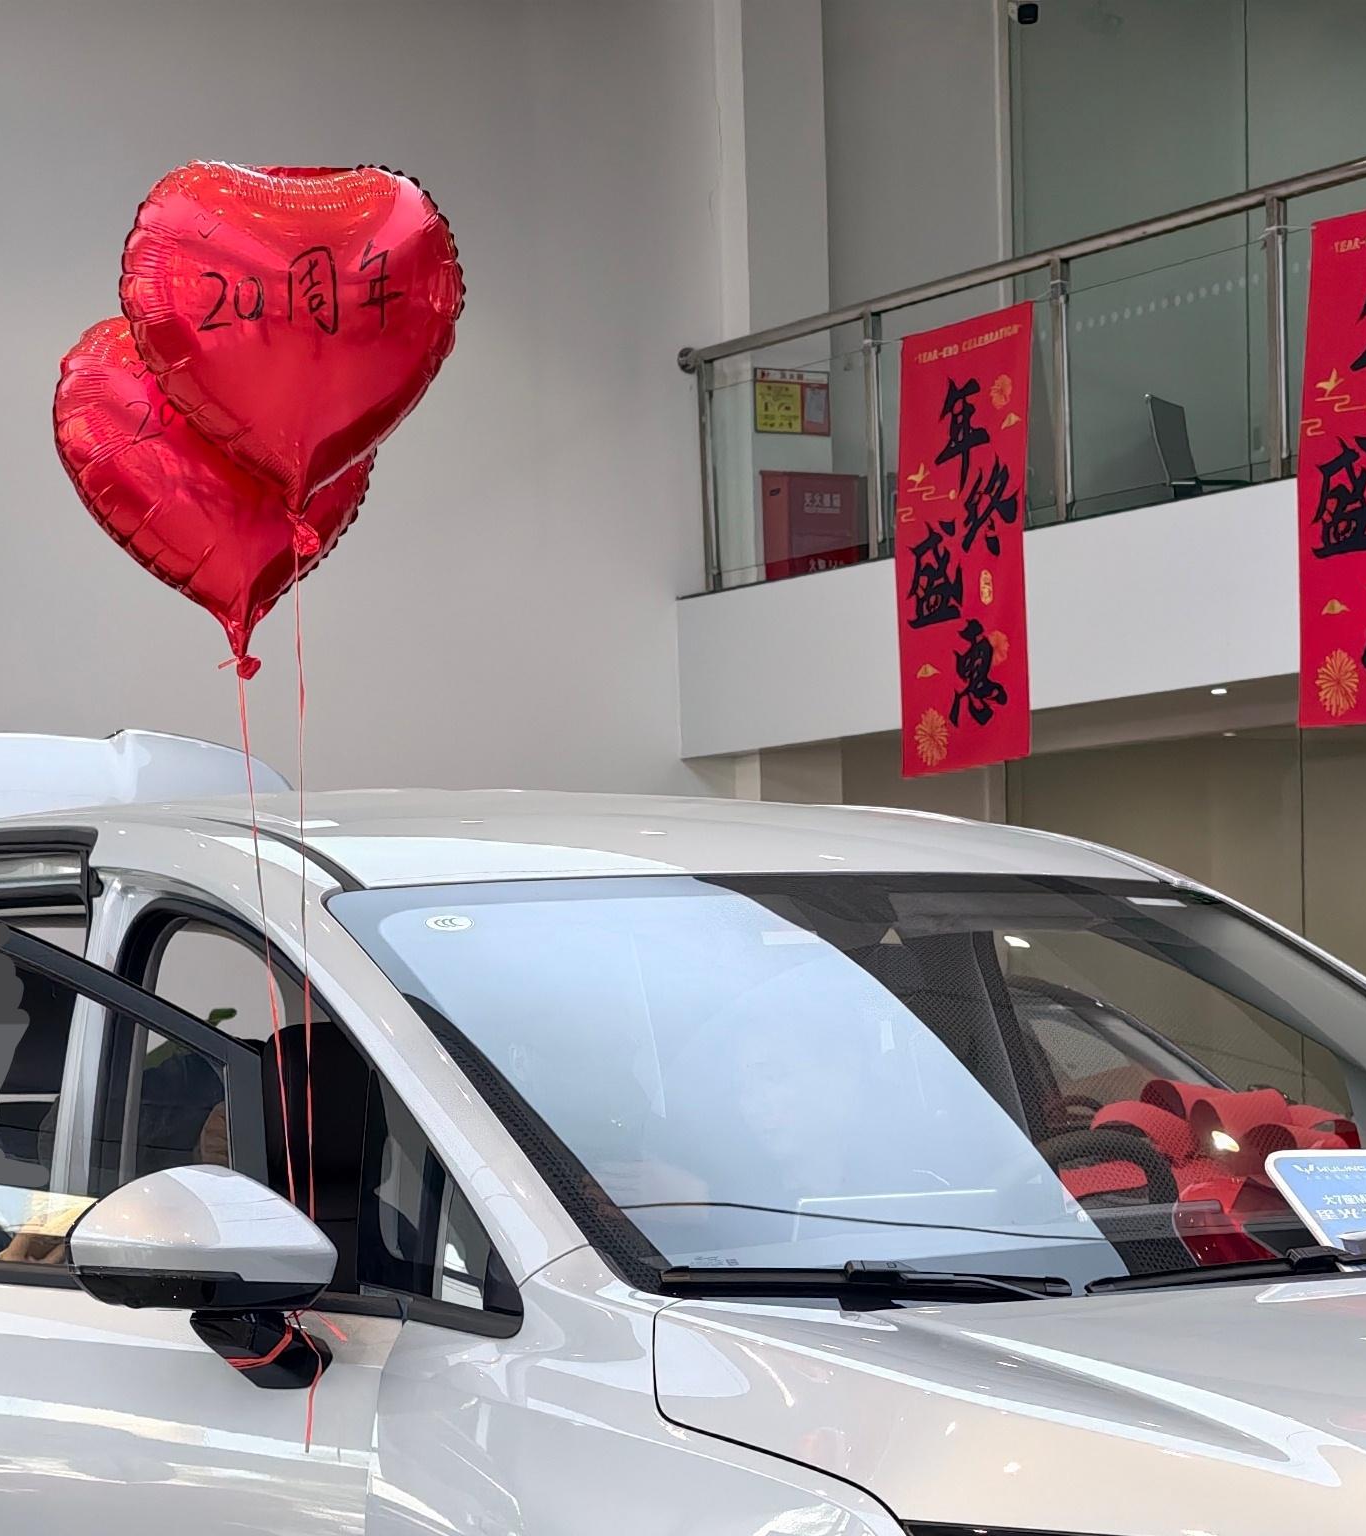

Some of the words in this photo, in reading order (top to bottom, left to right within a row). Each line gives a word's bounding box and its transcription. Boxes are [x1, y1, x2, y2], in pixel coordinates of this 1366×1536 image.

[197, 240, 402, 334] 20周年
[906, 376, 1019, 728] 年终盛惠
